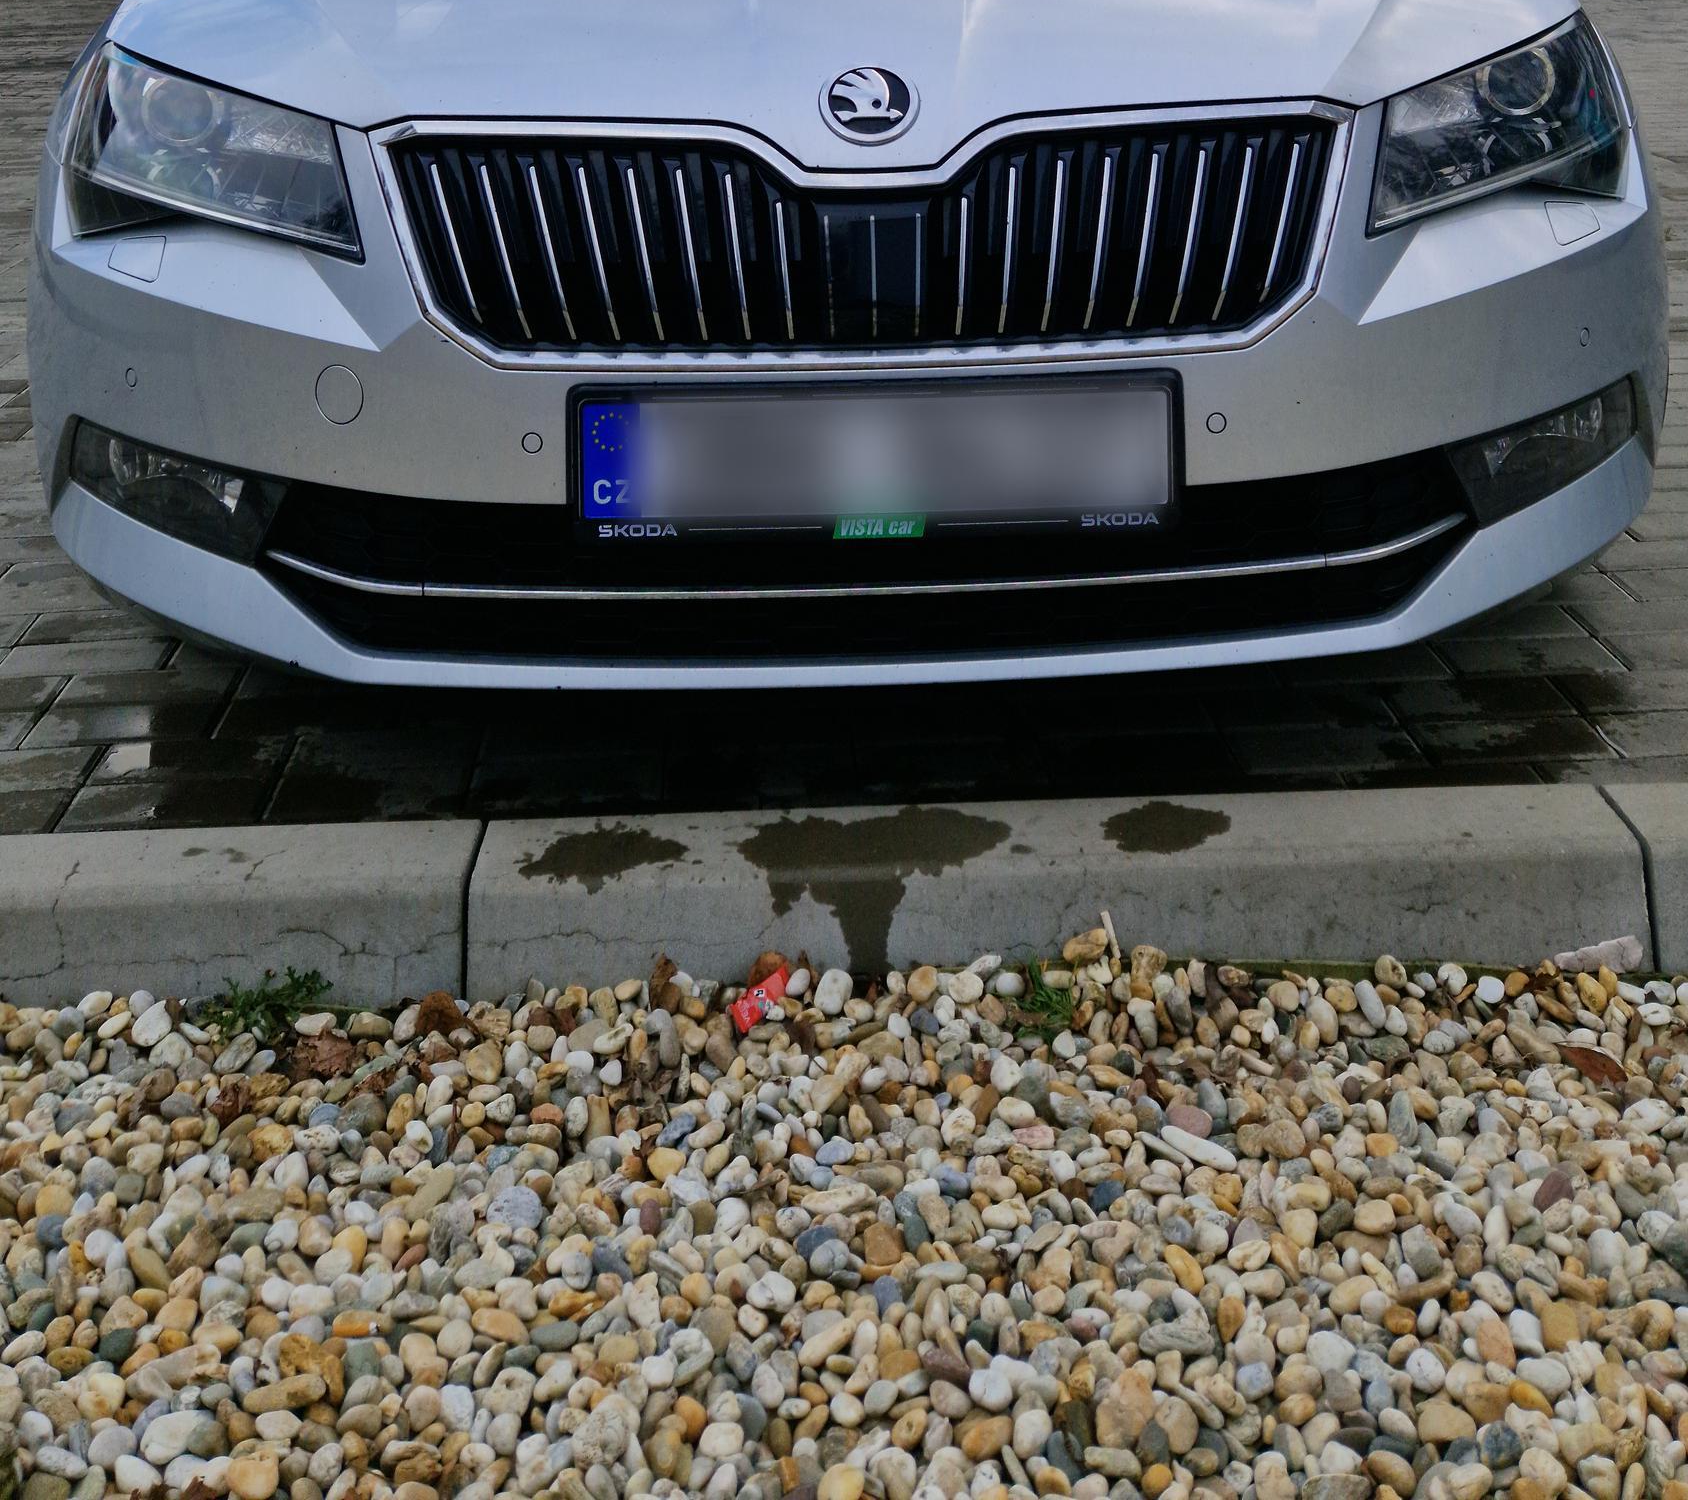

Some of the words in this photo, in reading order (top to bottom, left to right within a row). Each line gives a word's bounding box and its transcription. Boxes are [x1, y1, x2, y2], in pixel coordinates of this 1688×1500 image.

[593, 479, 631, 505] CZ
[840, 518, 883, 536] VISTA
[888, 520, 916, 535] car
